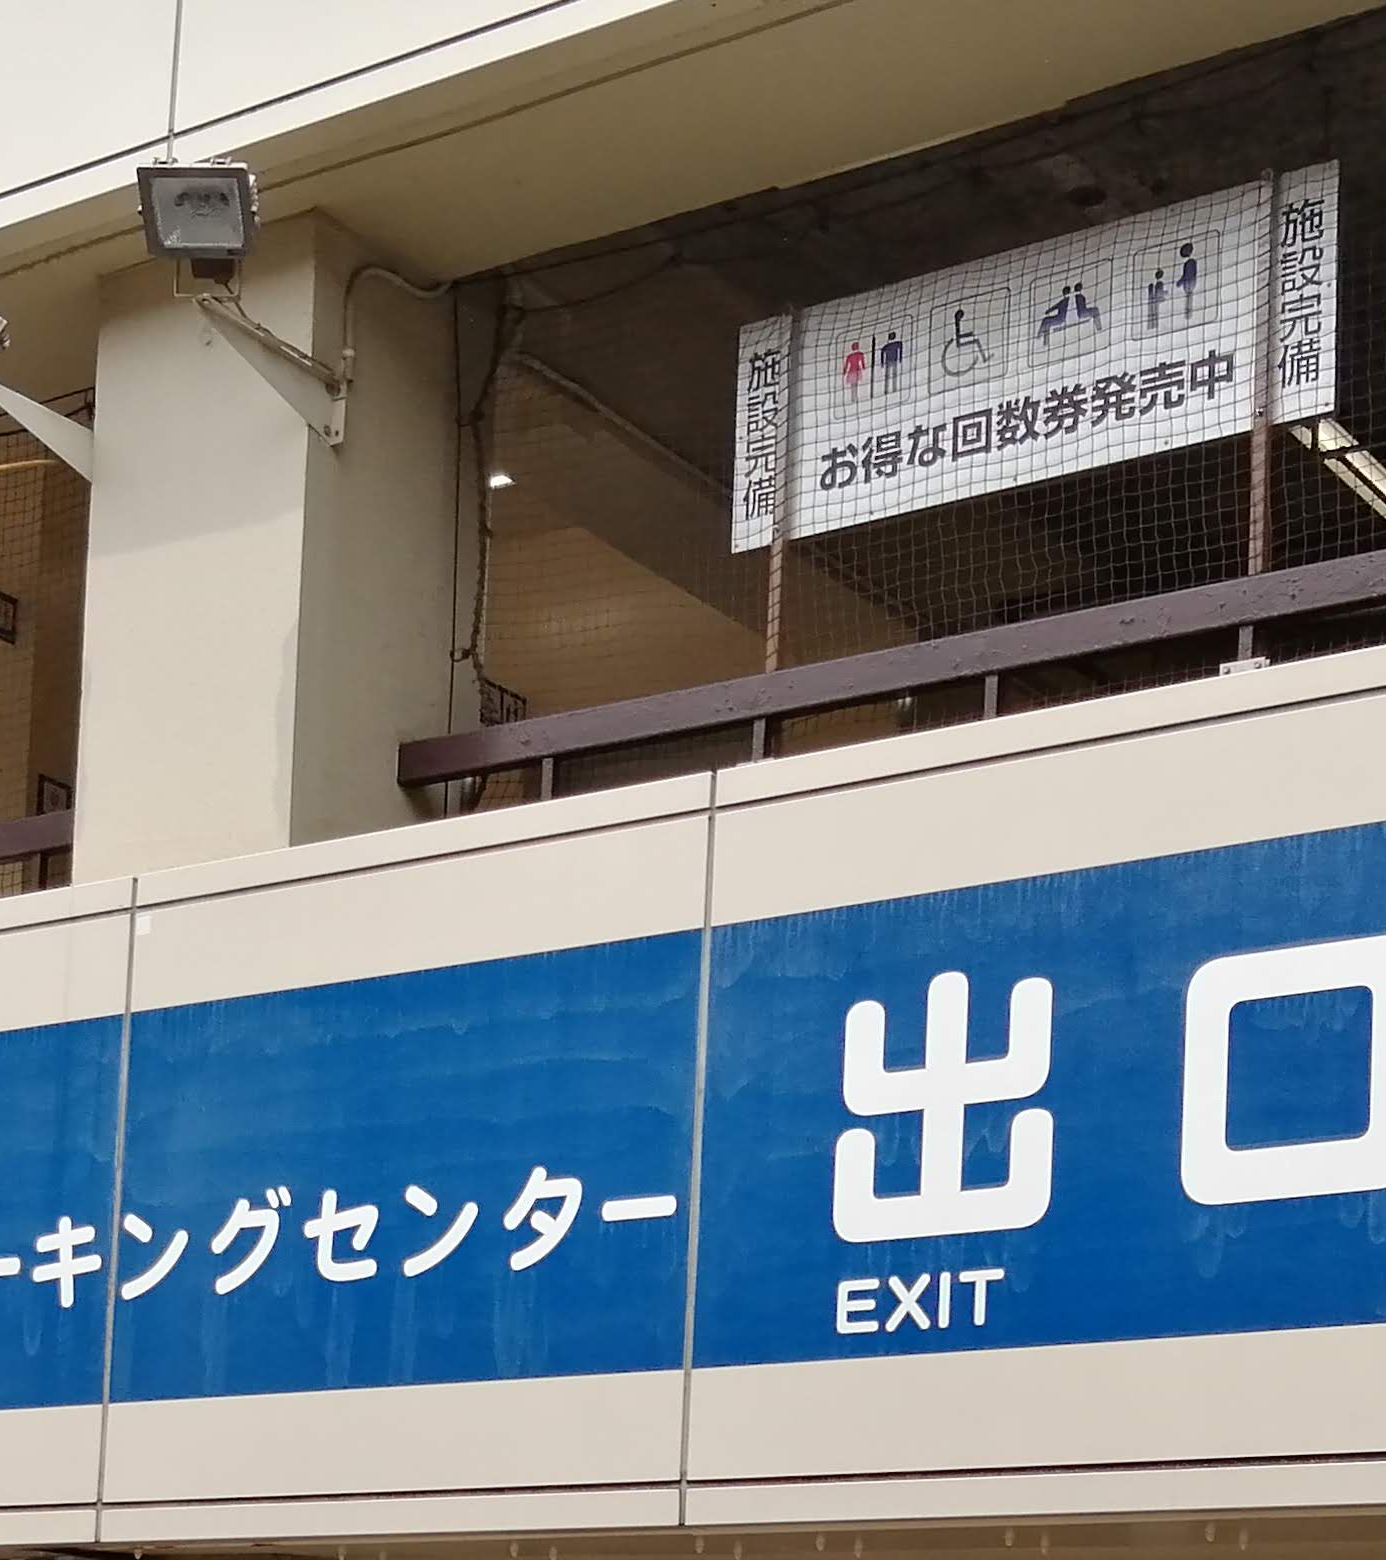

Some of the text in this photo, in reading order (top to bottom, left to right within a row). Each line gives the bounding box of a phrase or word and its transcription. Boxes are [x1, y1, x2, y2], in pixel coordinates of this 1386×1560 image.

[1278, 198, 1326, 388] 施設完備
[742, 348, 784, 520] 施設完備
[818, 349, 1235, 492] お得な回数券発売中
[835, 1267, 1006, 1335] EXIT
